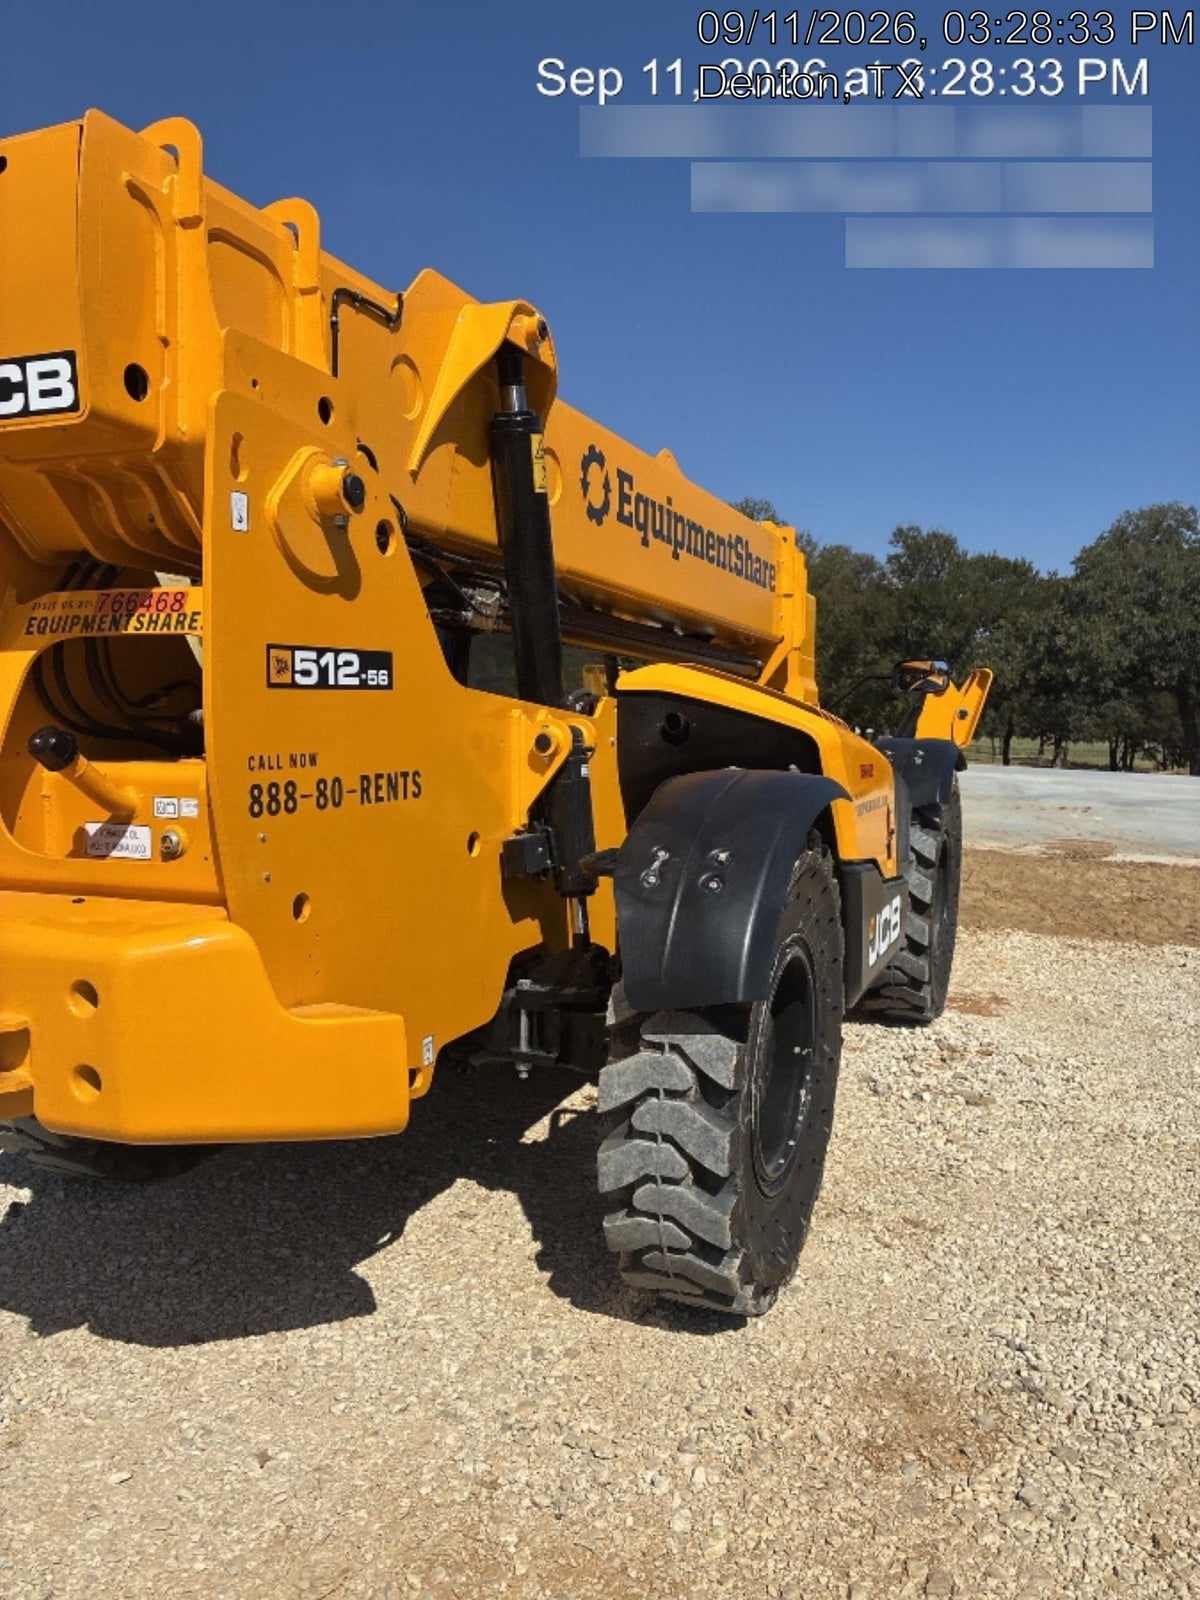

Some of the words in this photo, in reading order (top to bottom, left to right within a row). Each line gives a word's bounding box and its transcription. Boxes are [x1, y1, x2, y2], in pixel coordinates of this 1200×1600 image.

[616, 467, 776, 592] EquipmentShare
[98, 591, 185, 613] 766468
[294, 650, 389, 686] 512-56
[248, 755, 283, 771] CALL
[290, 752, 318, 768] NOW
[249, 769, 422, 818] 888-80-RENTS
[868, 895, 902, 967] JCB
